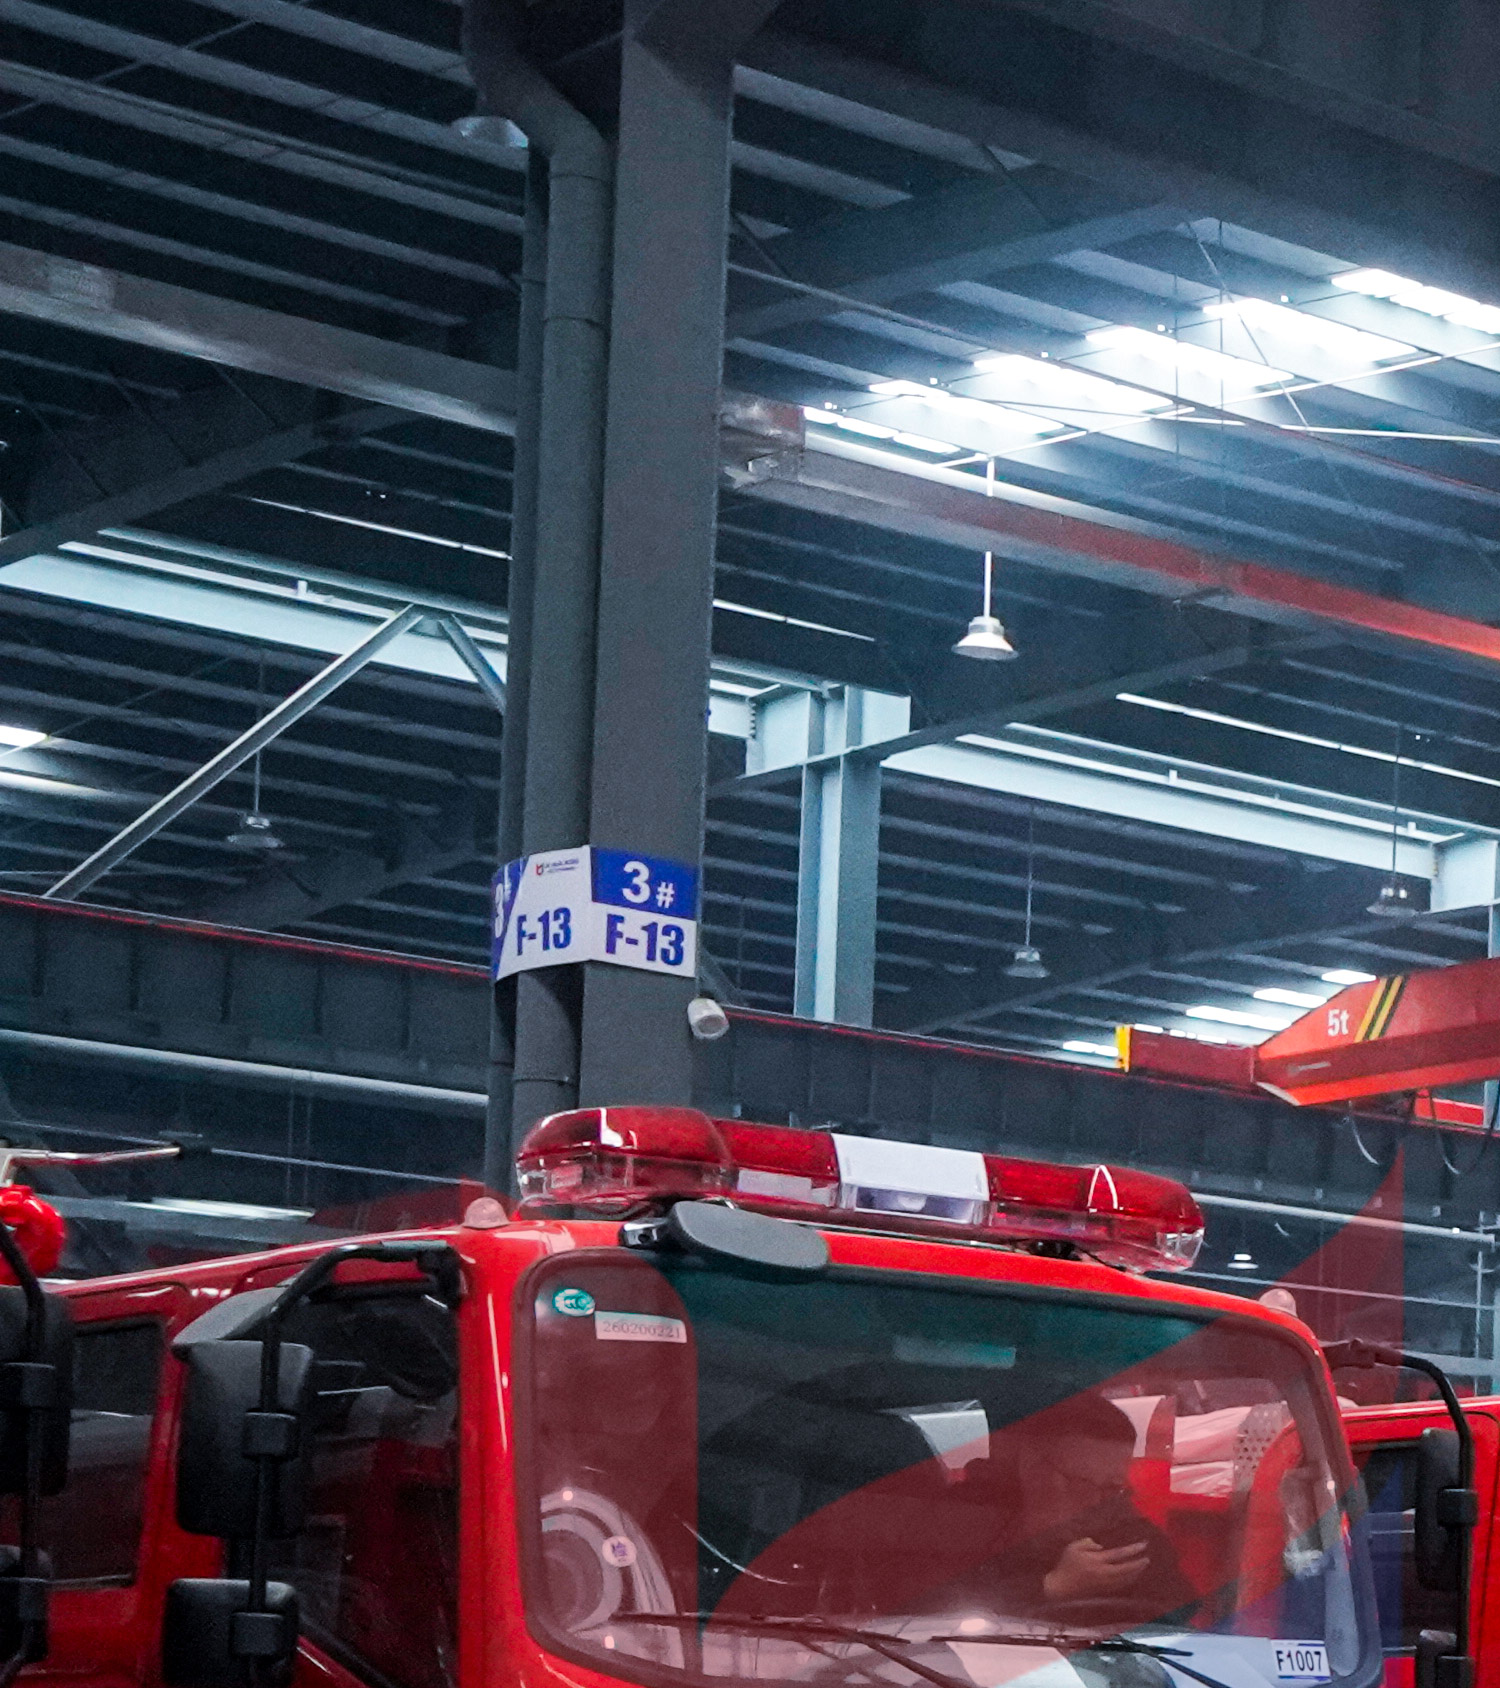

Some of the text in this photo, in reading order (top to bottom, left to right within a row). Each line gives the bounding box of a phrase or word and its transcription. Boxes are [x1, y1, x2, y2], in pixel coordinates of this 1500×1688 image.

[622, 861, 675, 909] 3#
[517, 907, 571, 955] F-13
[606, 913, 684, 966] F-13
[1327, 1008, 1350, 1037] 5t
[1276, 1650, 1321, 1671] F1007
